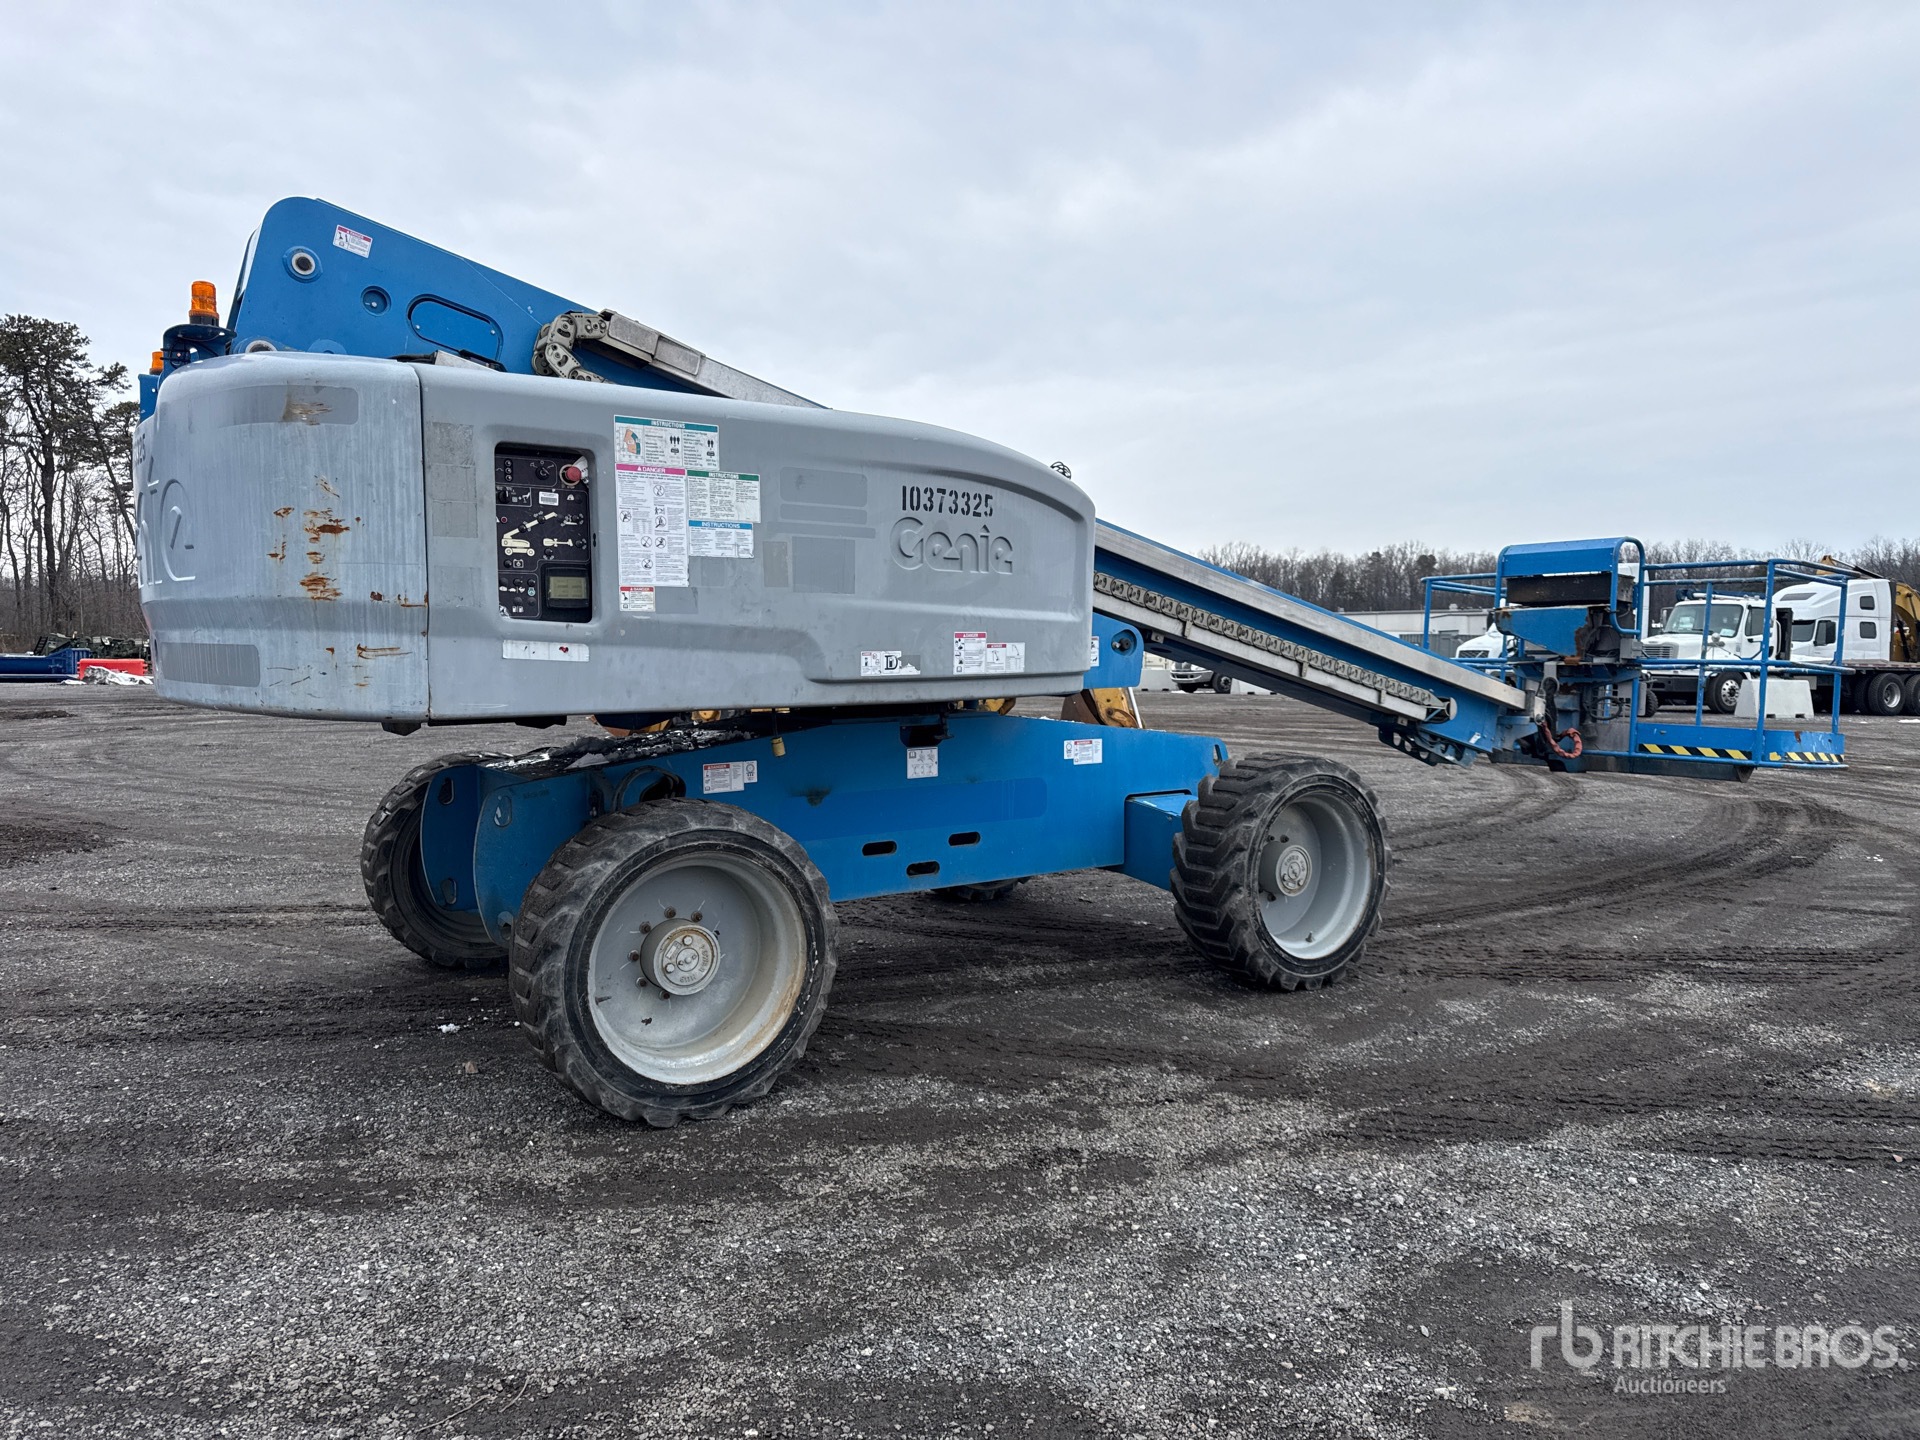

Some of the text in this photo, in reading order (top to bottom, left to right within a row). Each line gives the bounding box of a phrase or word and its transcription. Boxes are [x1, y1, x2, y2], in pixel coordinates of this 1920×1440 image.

[650, 421, 686, 430] INSTRUCTIONS
[642, 466, 666, 474] DANGER
[708, 472, 740, 480] INSTRUCTIONS
[901, 484, 994, 517] 10373325
[701, 521, 741, 529] INSTRUCTIONS
[890, 516, 1013, 575] Genie
